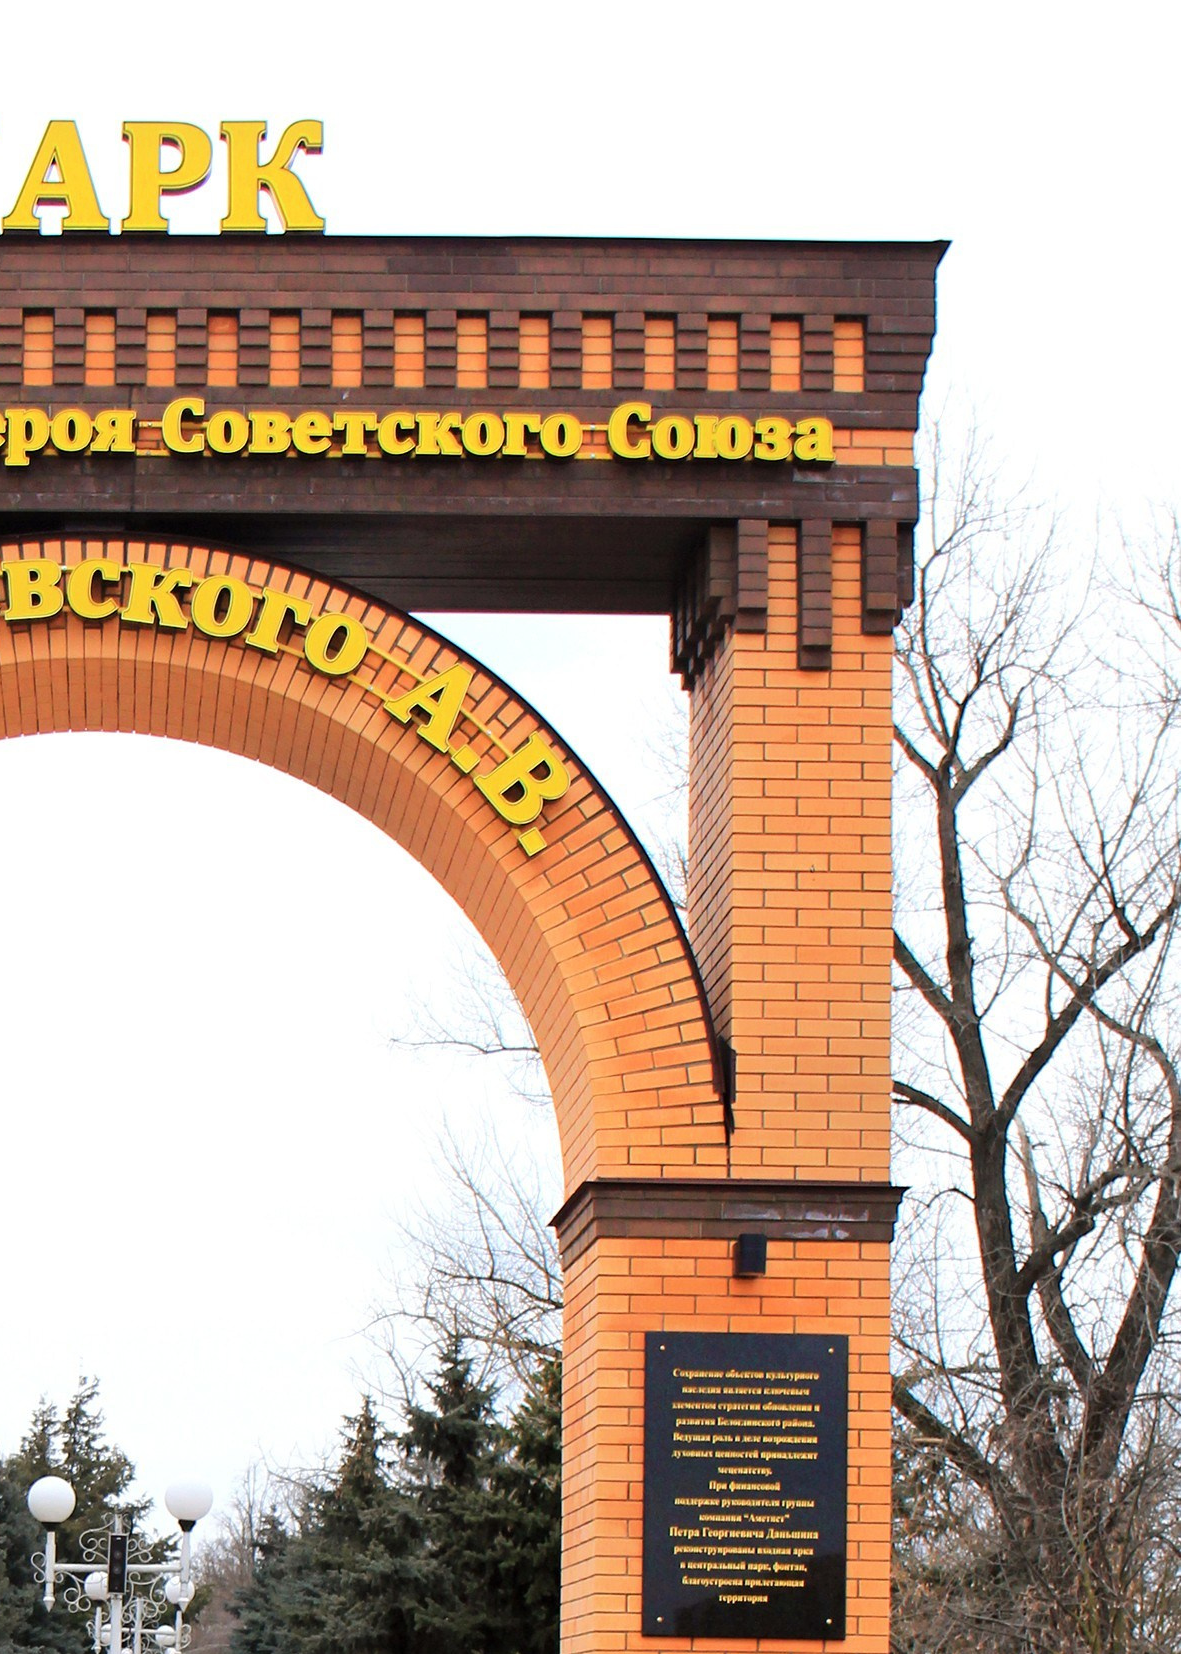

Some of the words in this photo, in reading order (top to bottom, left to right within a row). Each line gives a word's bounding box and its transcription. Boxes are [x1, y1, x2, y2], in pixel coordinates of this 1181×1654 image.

[160, 397, 583, 459] Советского
[607, 401, 836, 467] Союза
[766, 1372, 819, 1381] культурного
[709, 1481, 727, 1491] При
[729, 1481, 780, 1492] финансовой
[670, 1527, 700, 1538] Петра
[702, 1527, 764, 1539] Георгиевича
